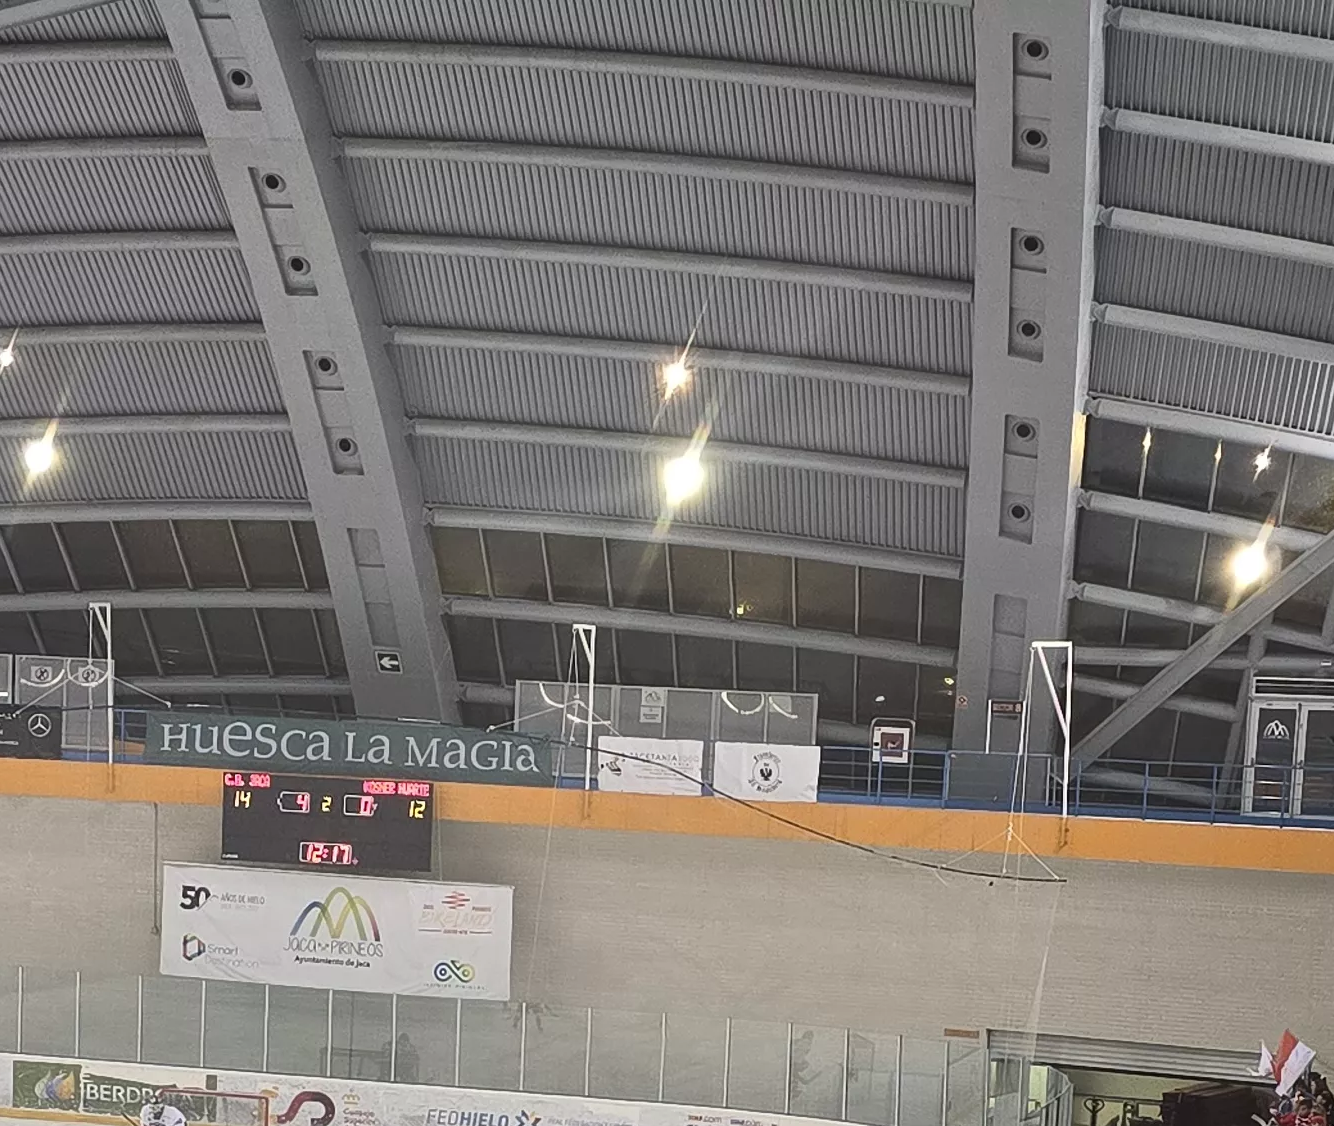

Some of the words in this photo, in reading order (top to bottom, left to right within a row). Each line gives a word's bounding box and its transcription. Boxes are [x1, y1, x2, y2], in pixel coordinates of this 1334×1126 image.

[234, 790, 251, 808] 14
[296, 794, 309, 813] 4
[321, 796, 332, 812] 2
[408, 800, 426, 819] 12
[306, 843, 350, 864] 12:17
[179, 884, 212, 910] 50
[207, 944, 239, 956] Smart
[294, 955, 344, 966] Ayuntamiento
